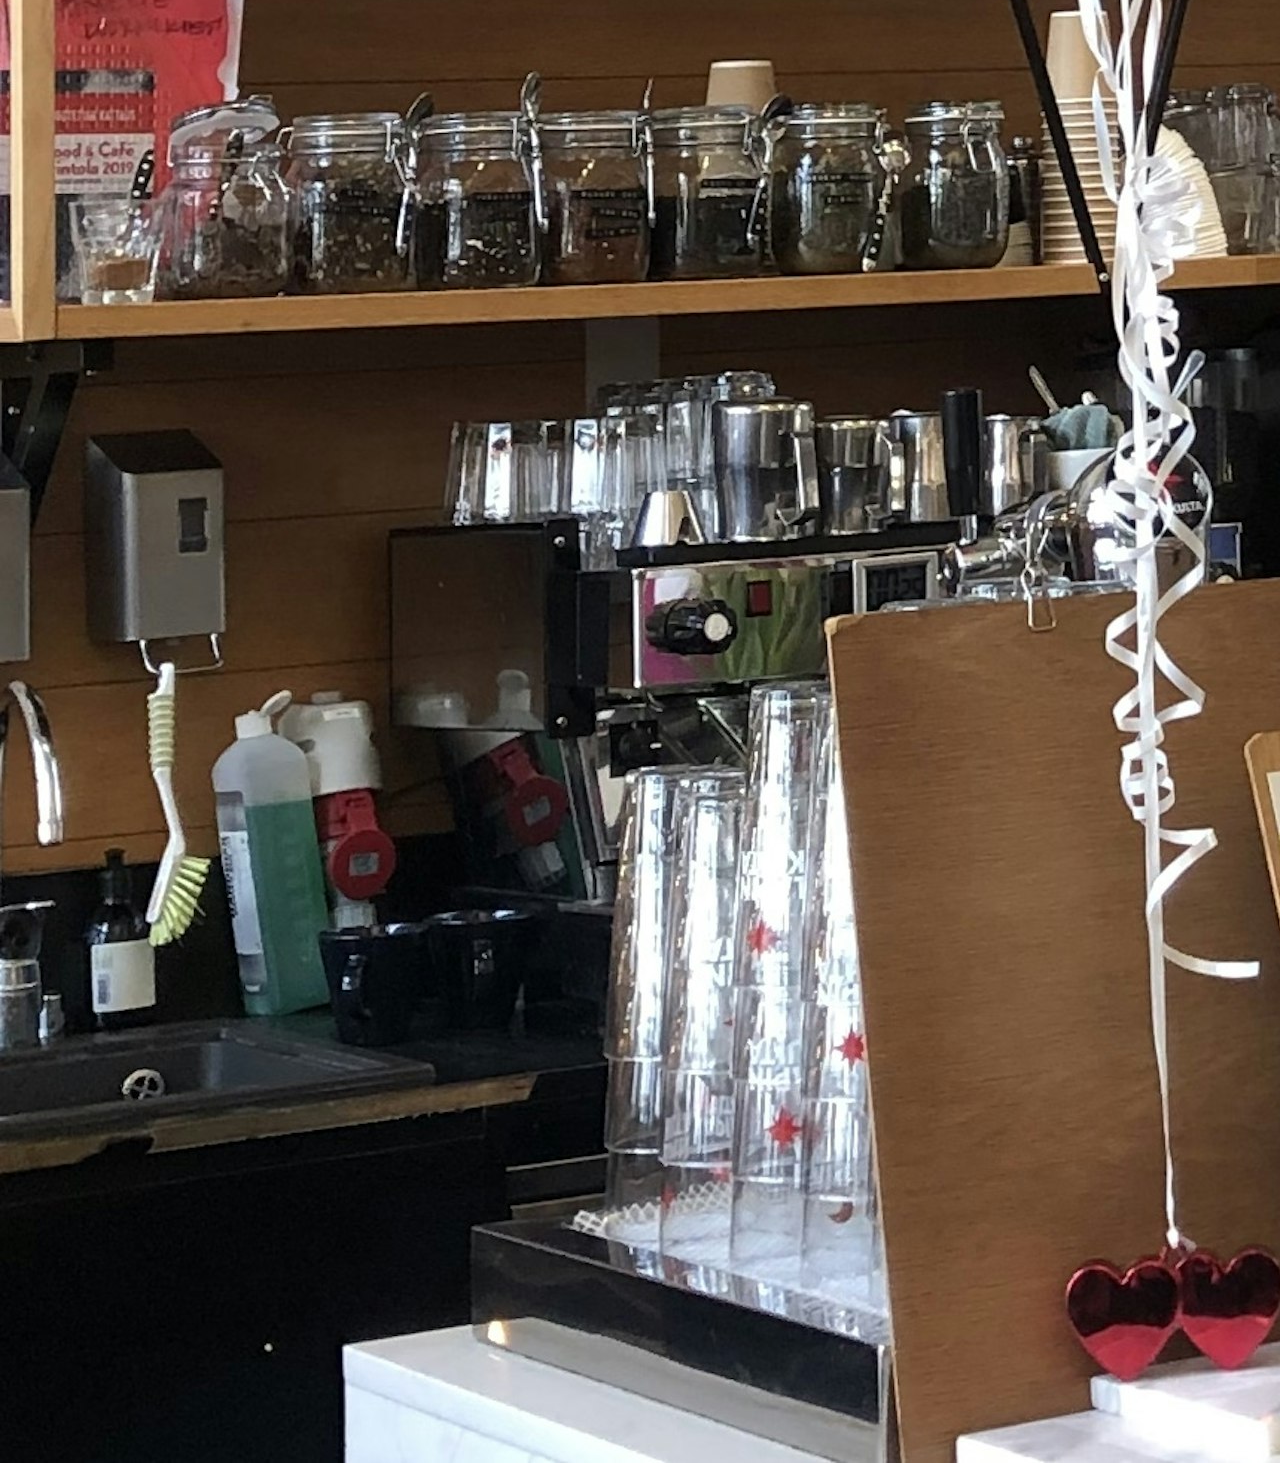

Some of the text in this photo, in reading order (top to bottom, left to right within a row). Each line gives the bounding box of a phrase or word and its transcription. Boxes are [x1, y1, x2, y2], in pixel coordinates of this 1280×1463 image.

[55, 142, 82, 158] ood
[56, 157, 134, 175] intola 2019
